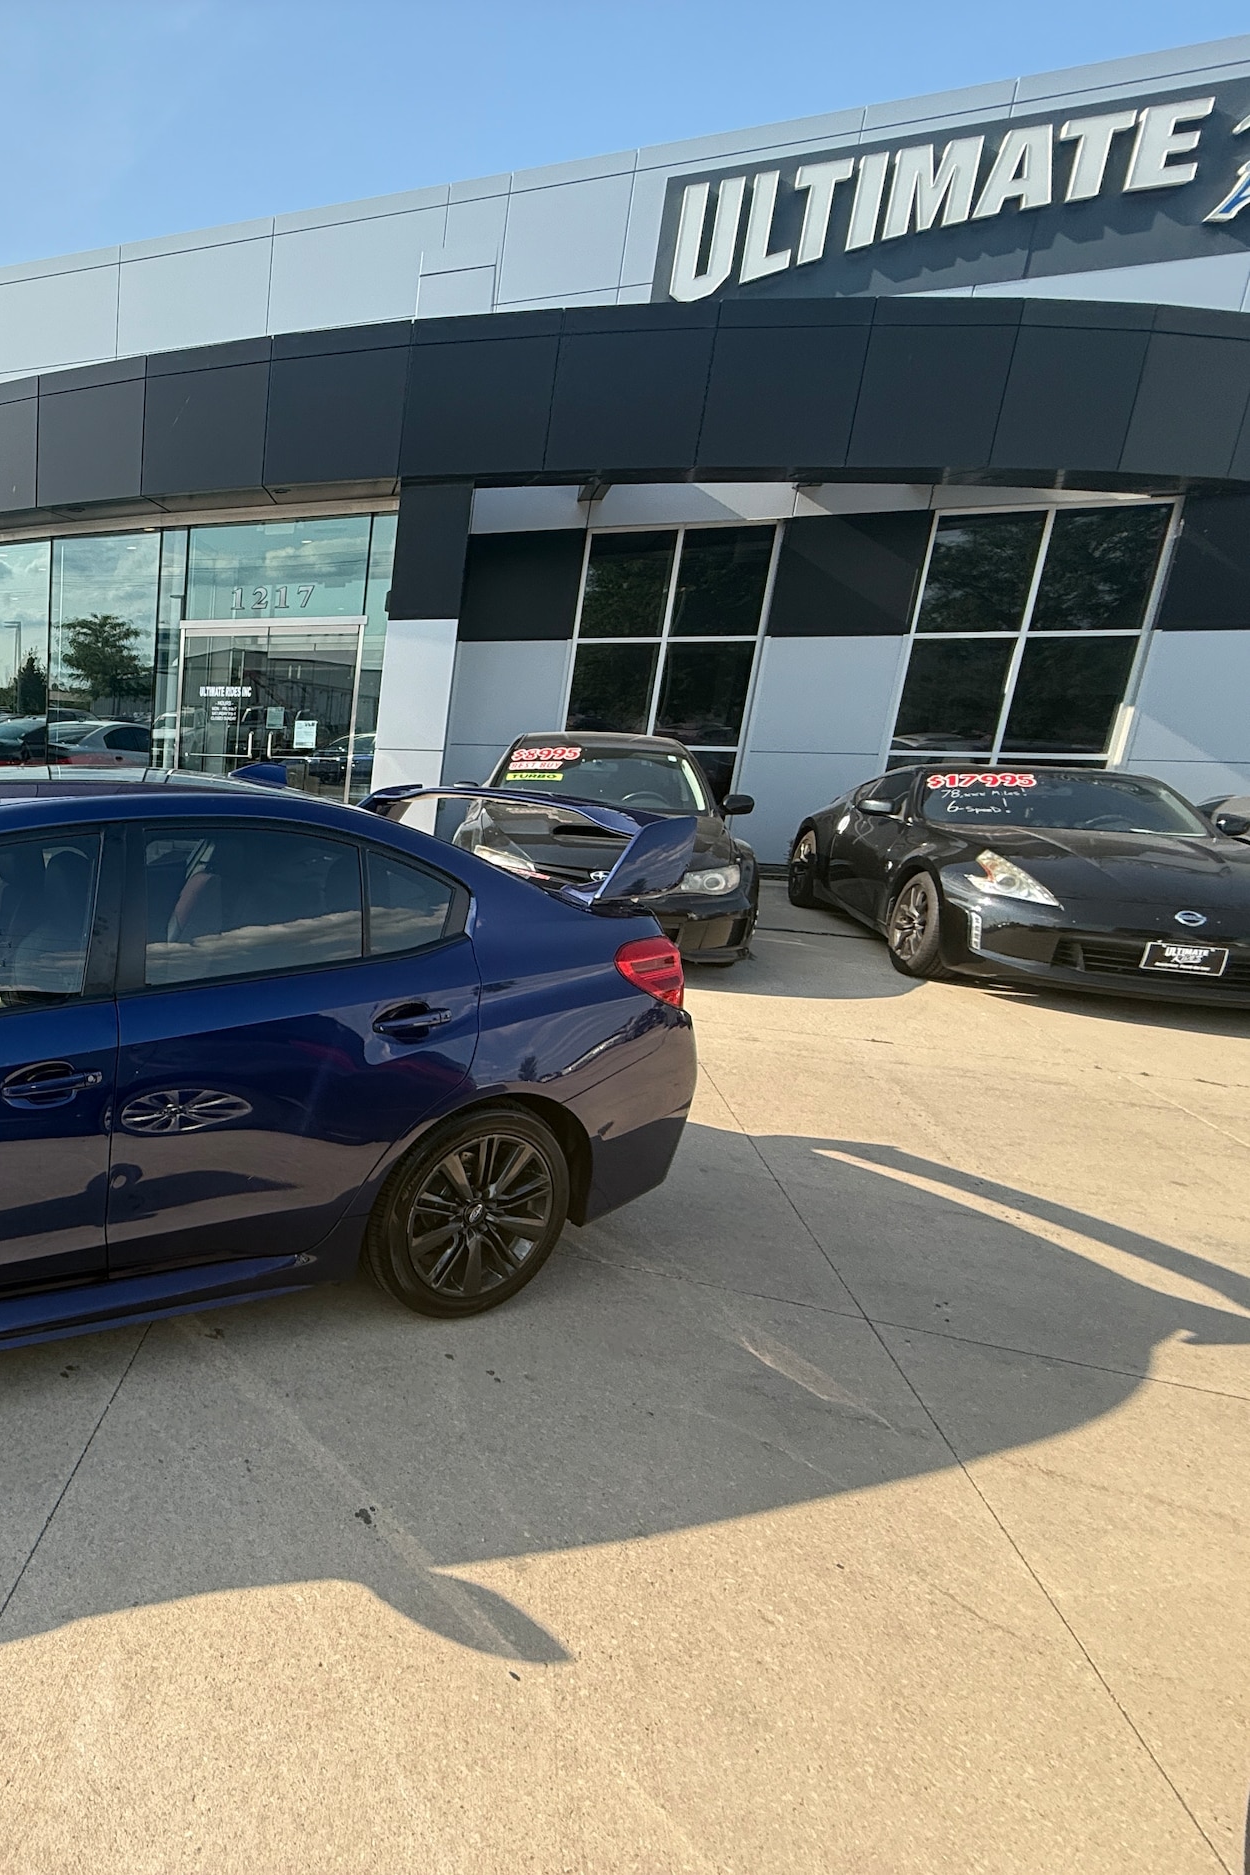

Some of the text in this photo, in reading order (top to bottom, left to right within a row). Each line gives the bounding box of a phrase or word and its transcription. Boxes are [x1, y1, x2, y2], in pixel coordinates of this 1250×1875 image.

[669, 96, 1217, 302] ULTIMATE
[230, 585, 315, 610] 1217
[199, 686, 225, 697] ULTIMATE
[927, 773, 1037, 789] $17995
[1164, 946, 1210, 957] ULTIMATE
